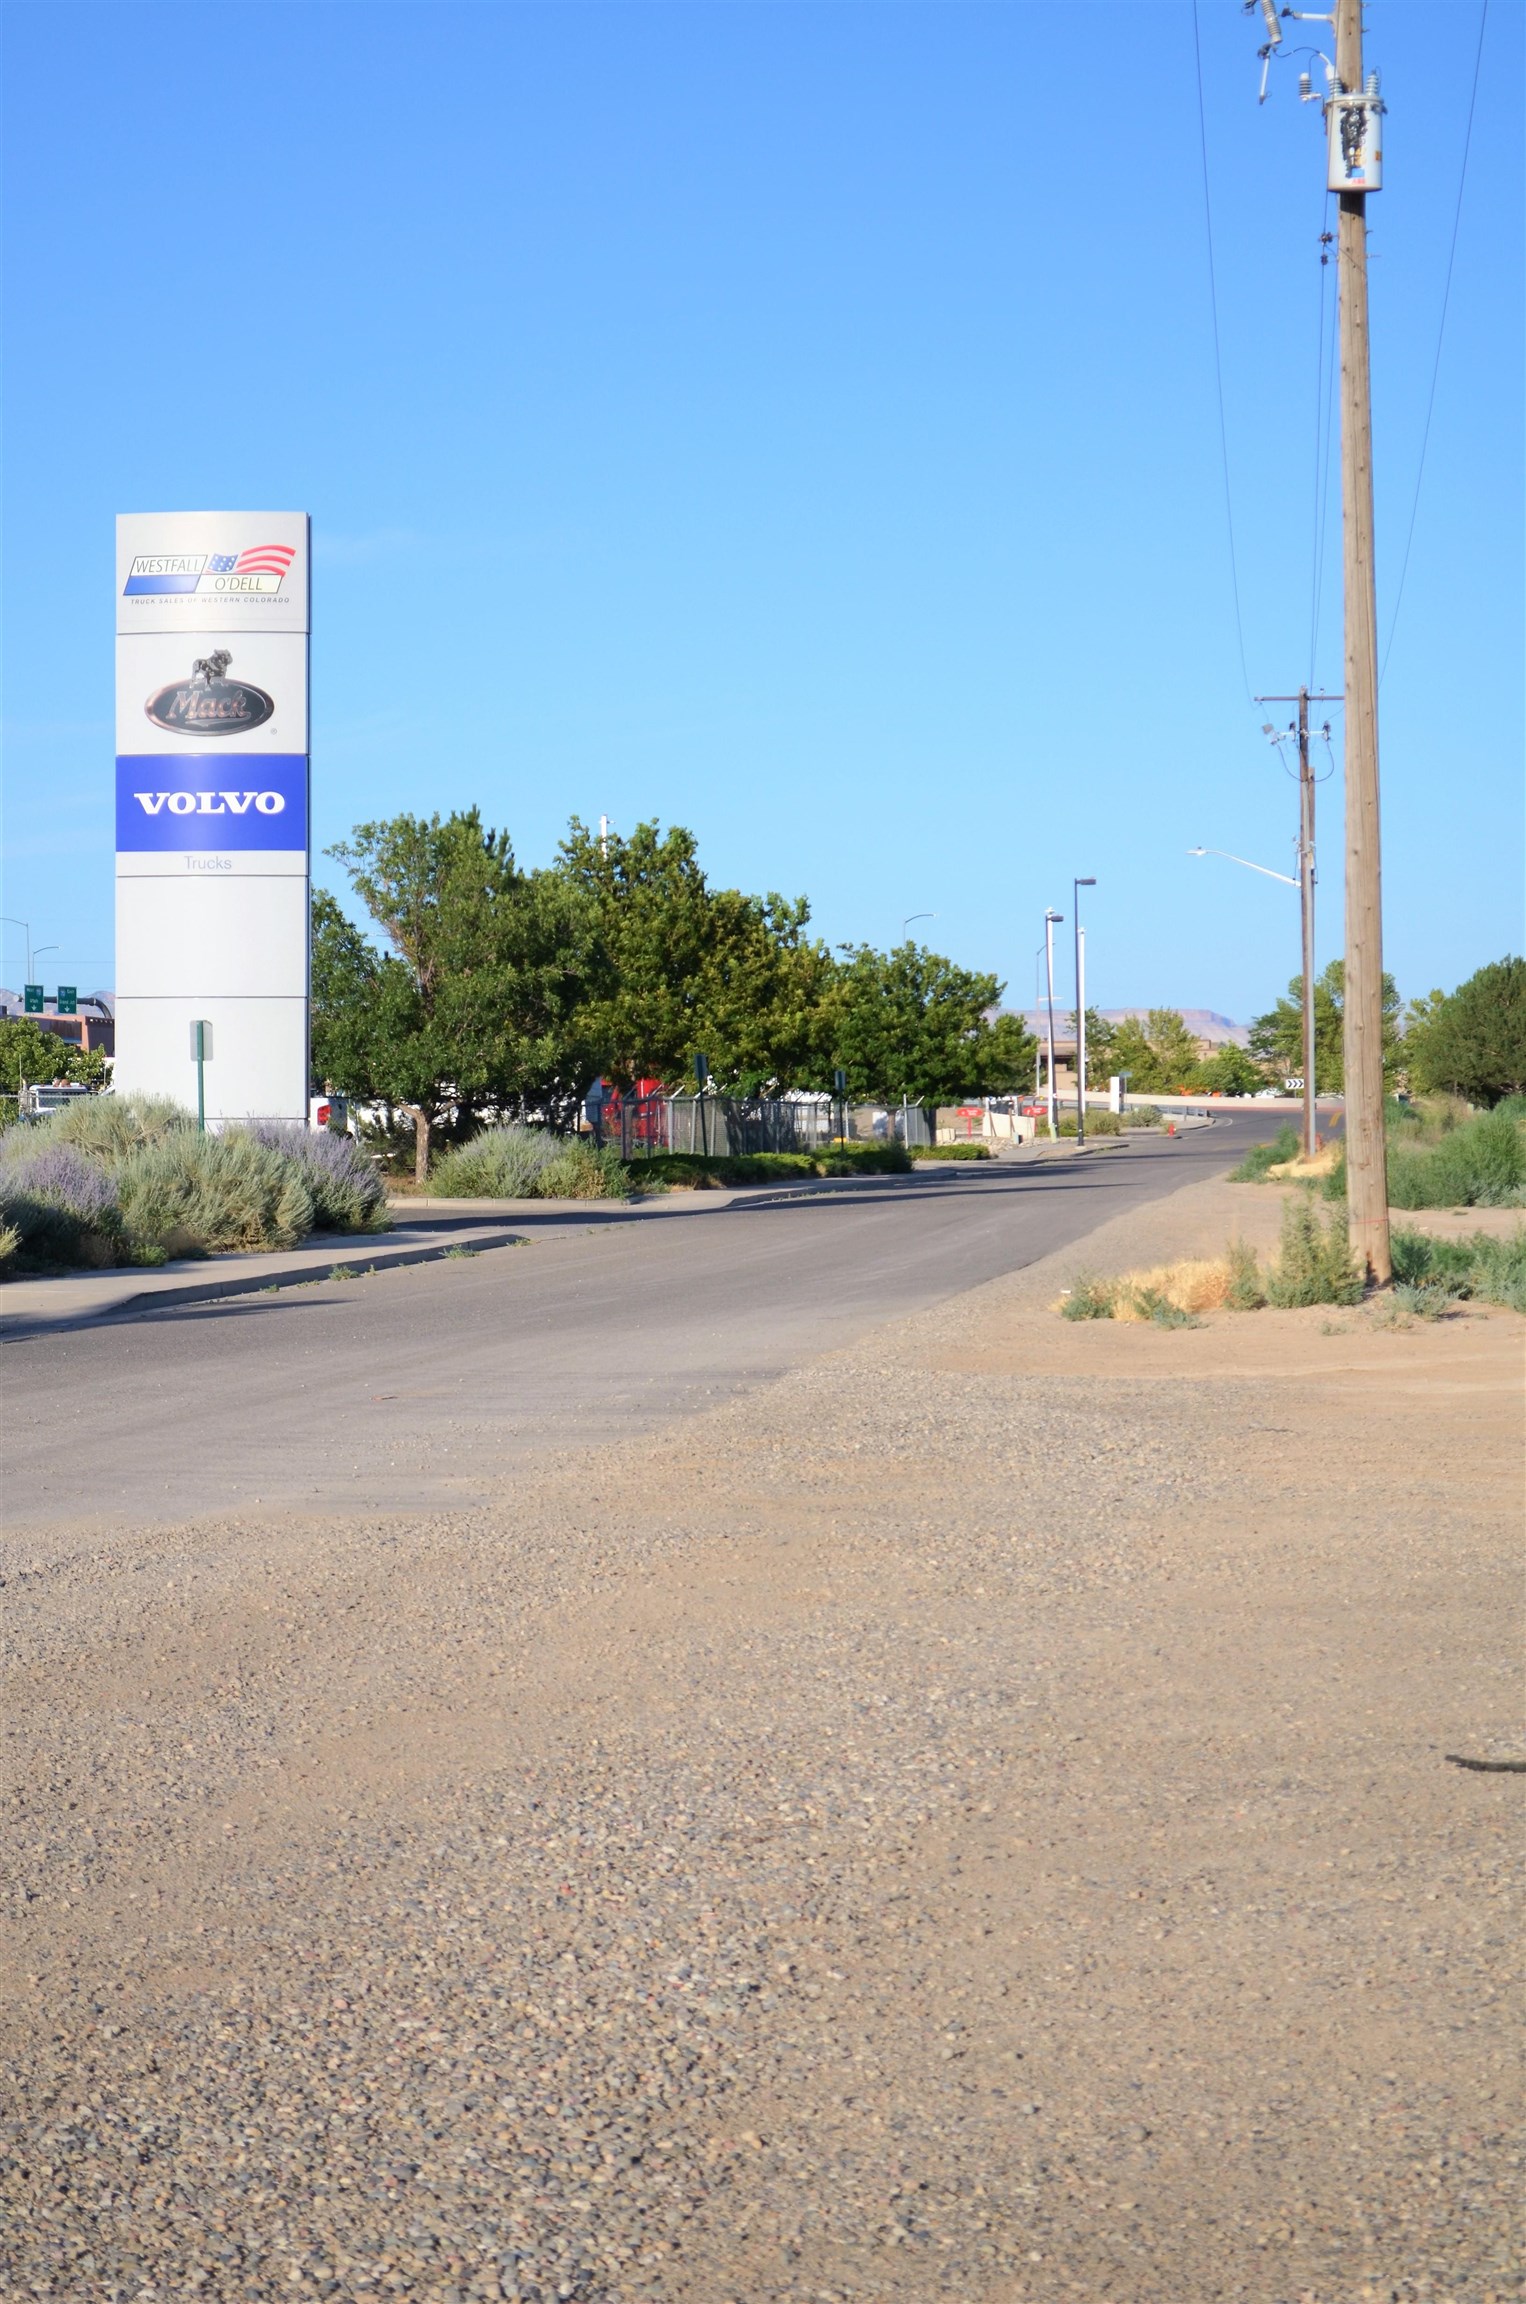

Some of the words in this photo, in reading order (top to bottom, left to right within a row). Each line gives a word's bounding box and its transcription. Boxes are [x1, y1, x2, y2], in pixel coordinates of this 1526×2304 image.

[136, 559, 200, 573] WESTFALL
[214, 576, 262, 591] O'DELL
[165, 689, 251, 720] Mack
[134, 791, 285, 814] VOLVO
[184, 855, 232, 870] Trucks
